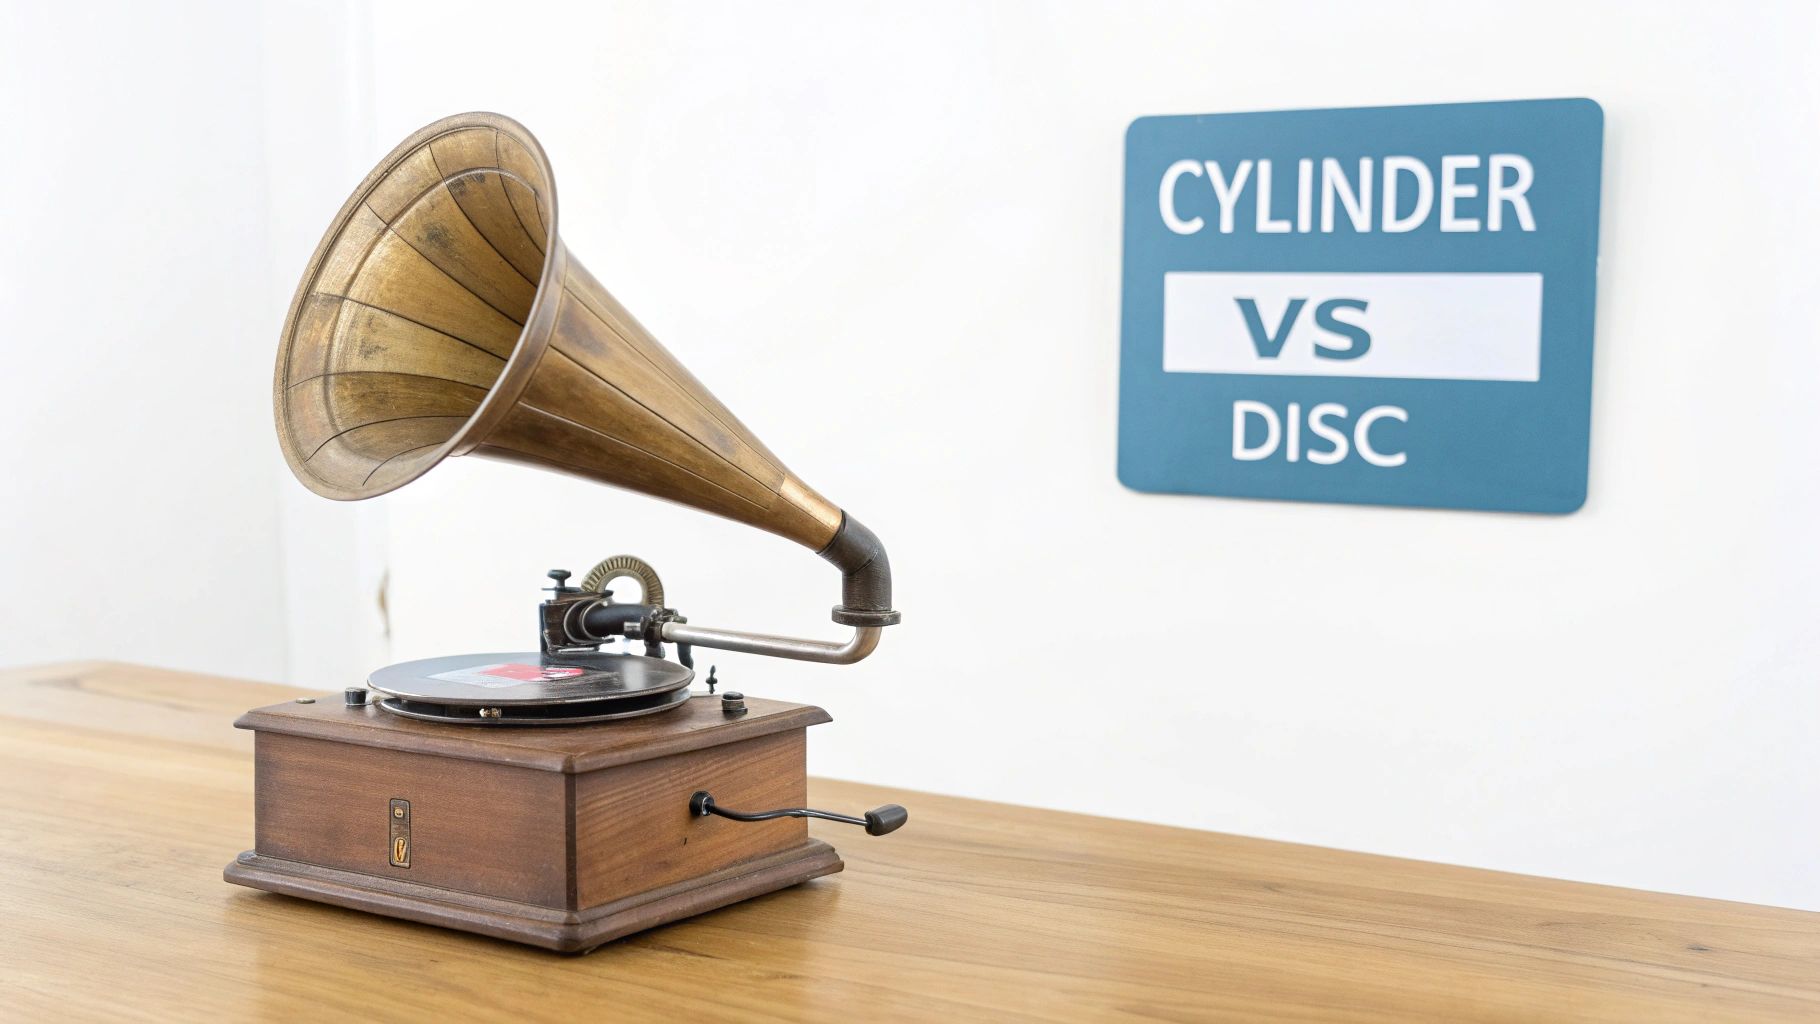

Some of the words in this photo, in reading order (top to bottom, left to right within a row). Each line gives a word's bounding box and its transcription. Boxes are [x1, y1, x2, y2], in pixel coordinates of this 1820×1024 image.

[1158, 154, 1536, 235] CYLINDER
[1234, 297, 1372, 361] VS
[1231, 400, 1409, 467] DISC
